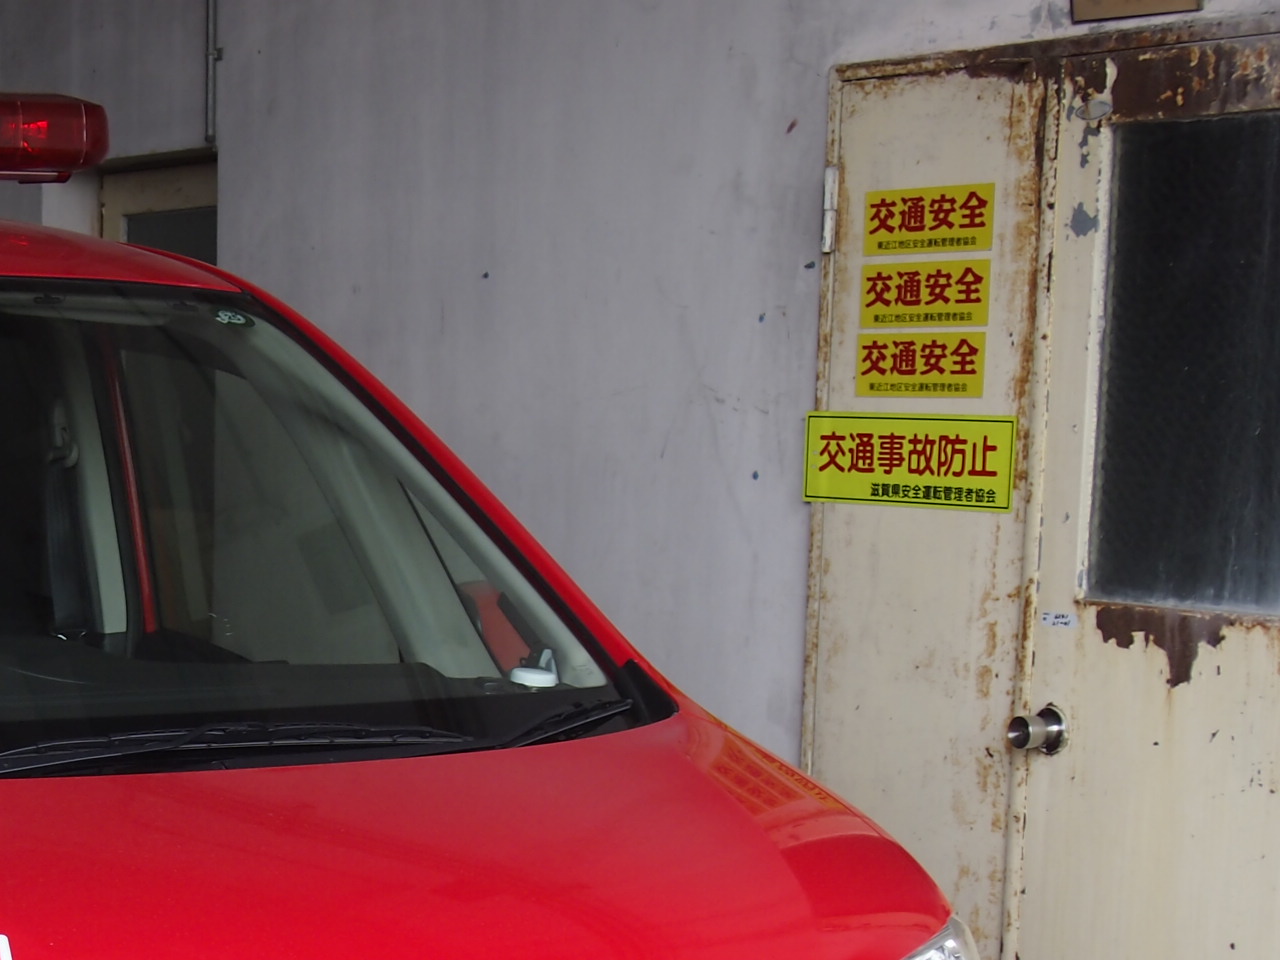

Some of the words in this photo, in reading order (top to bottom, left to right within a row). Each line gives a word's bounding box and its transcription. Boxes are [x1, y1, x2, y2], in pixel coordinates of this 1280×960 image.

[869, 191, 988, 235] 交通安全
[865, 267, 984, 308] 交通安全
[861, 338, 979, 376] 交通安全
[819, 432, 998, 477] 交通事故防止
[870, 482, 997, 504] 滋賀県安全運転管理者協会
